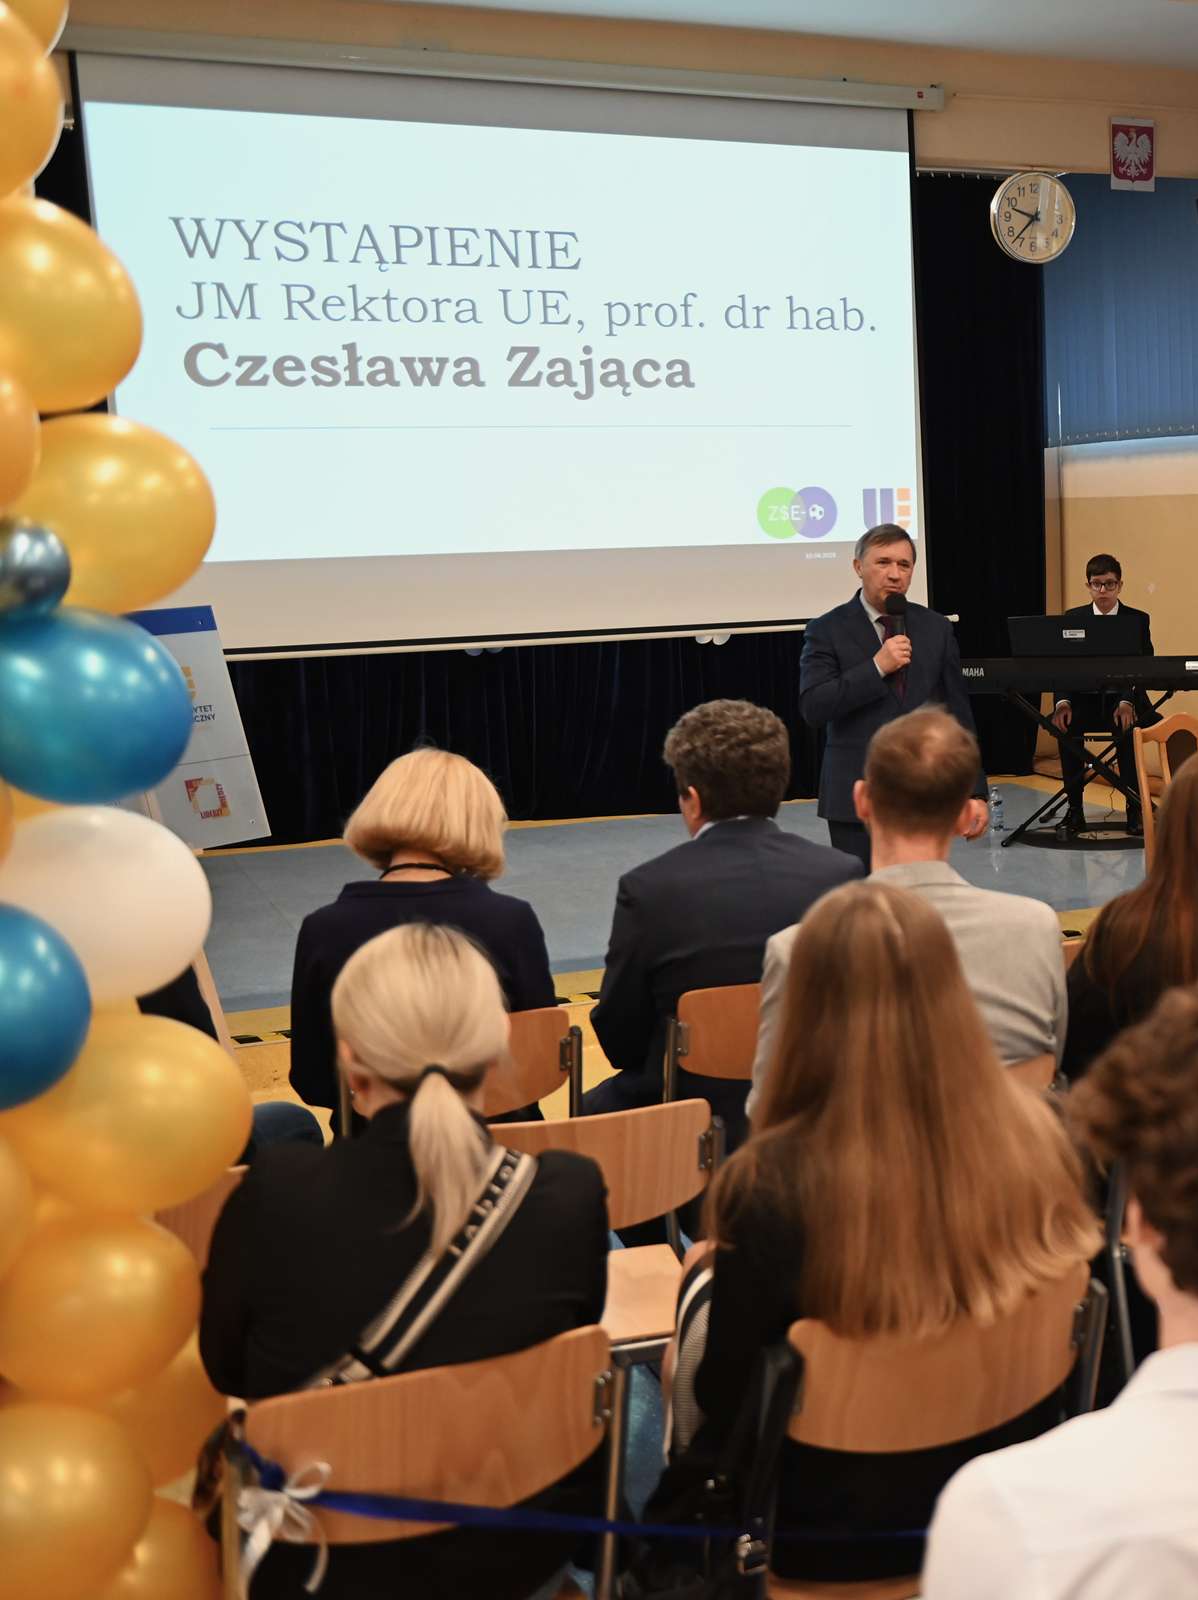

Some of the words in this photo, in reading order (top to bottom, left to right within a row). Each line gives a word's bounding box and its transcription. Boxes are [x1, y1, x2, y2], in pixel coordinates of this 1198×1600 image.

[1029, 183, 1039, 193] 12
[1006, 197, 1017, 208] 10
[1004, 211, 1011, 222] 9
[1007, 226, 1015, 237] 8
[168, 216, 582, 272] WYSTĄPIENIE
[176, 281, 262, 321] JM
[280, 283, 484, 324] Rektora
[498, 288, 585, 334] UE,
[603, 291, 705, 337] prof.
[725, 293, 772, 330] dr
[786, 294, 877, 332] hab.
[183, 341, 486, 388] Czesława
[505, 344, 696, 401] Zająca
[962, 667, 985, 677] MAHA
